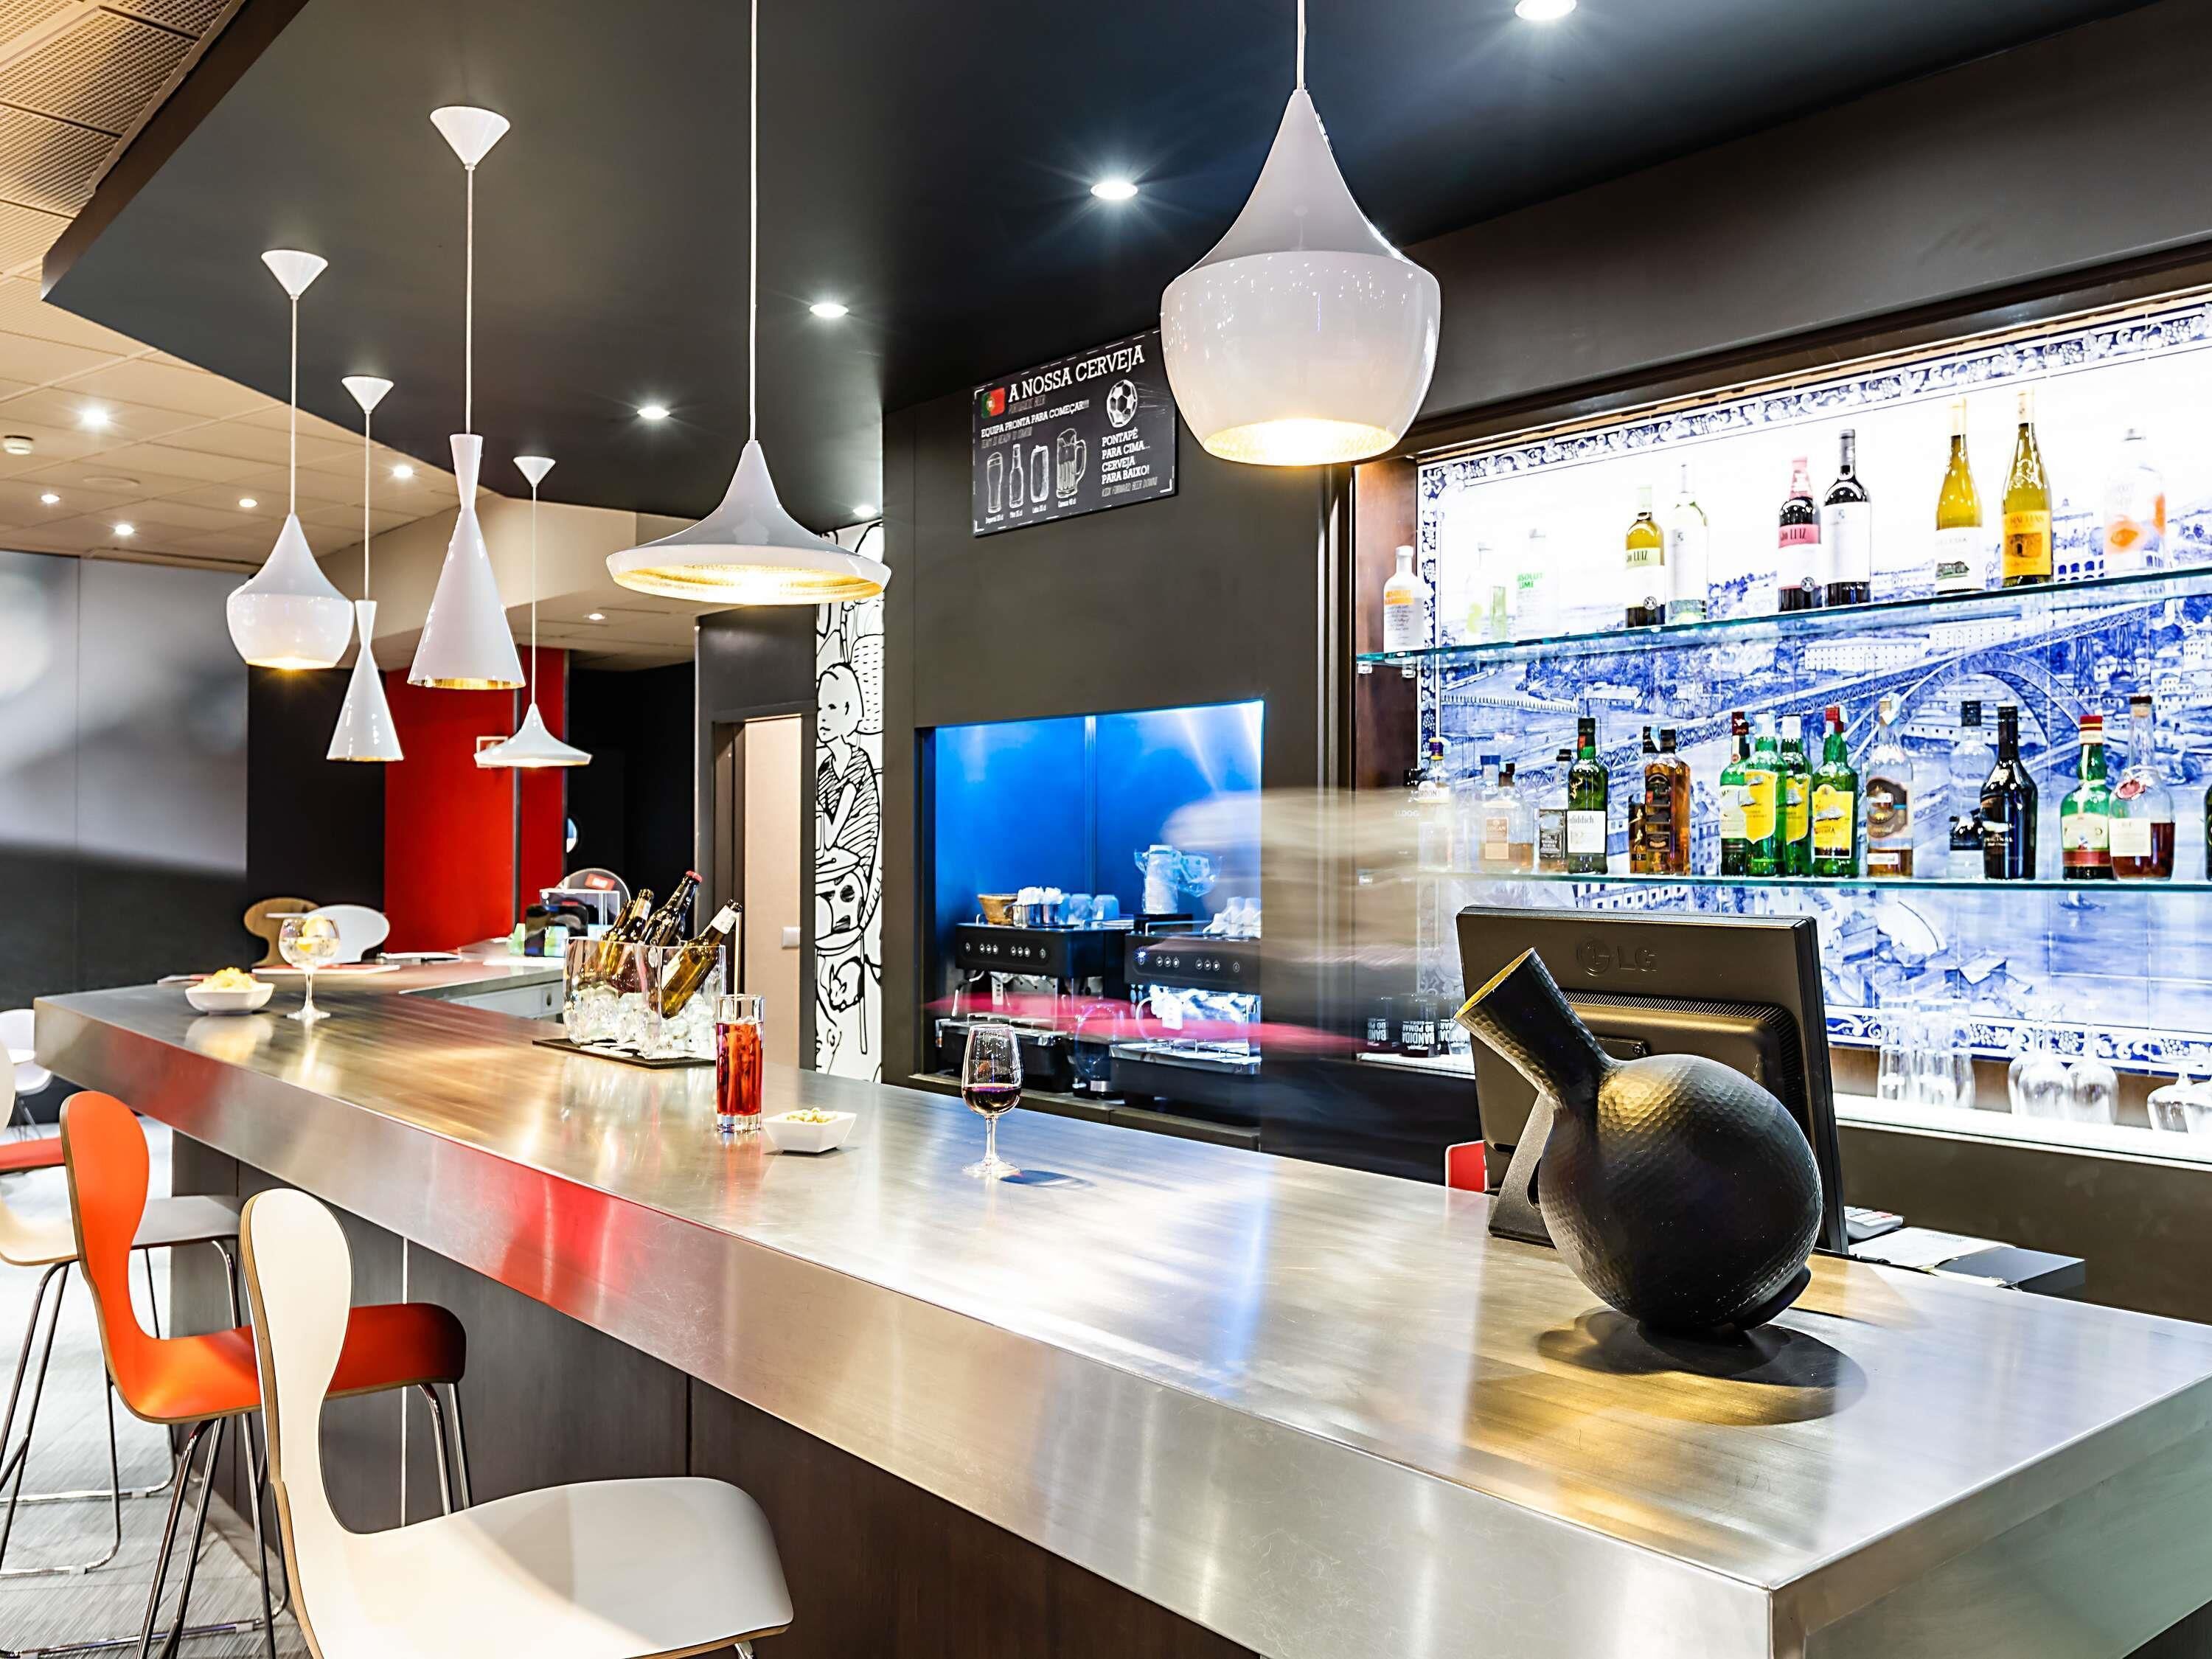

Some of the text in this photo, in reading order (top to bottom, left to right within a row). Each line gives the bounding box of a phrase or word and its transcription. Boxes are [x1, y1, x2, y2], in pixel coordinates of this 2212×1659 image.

[1008, 344, 1145, 403] A NOSSA CERVEJA
[981, 424, 1004, 438] EQUIPA
[1005, 416, 1031, 431] PRONTA
[1031, 411, 1048, 424] PARA
[1102, 426, 1138, 447] PONTAPÉ
[1102, 445, 1122, 460] PARA
[1102, 456, 1135, 473] CERVEJA
[1102, 465, 1150, 484] PARA BAIXO!
[1617, 945, 1658, 972] LG
[1402, 1032, 1435, 1045] BANDIDA
